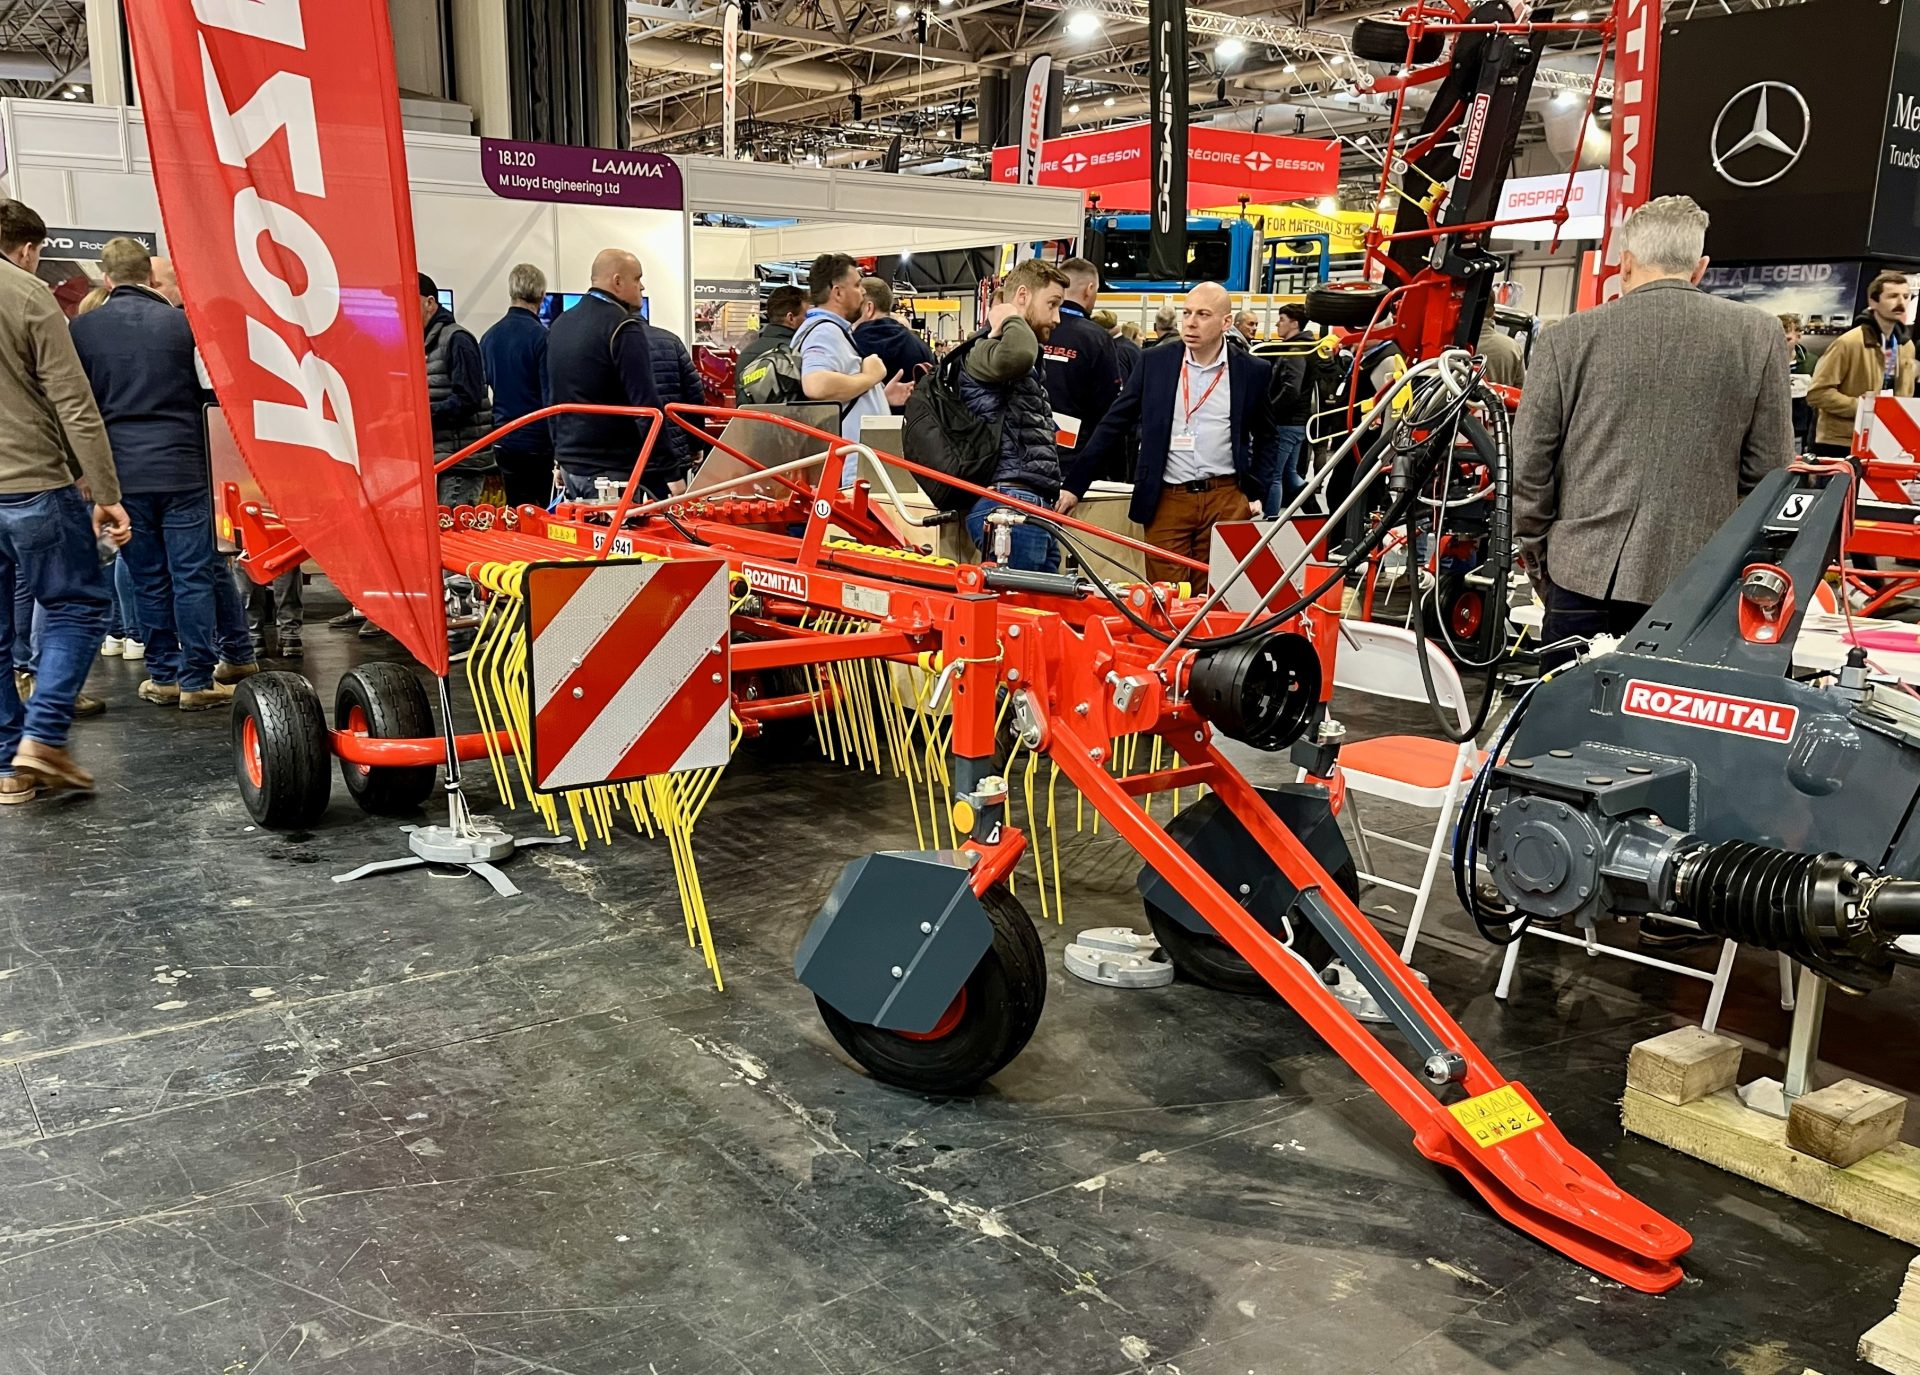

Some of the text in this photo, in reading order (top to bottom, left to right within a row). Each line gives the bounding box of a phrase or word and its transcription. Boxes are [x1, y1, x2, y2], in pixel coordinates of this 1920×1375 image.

[1461, 98, 1487, 174] ROZMITAL
[498, 149, 663, 179] 18.120 LAMMA
[1090, 148, 1140, 165] BESSON
[1187, 148, 1325, 172] RÉGOIRE BESSON
[1889, 144, 1920, 169] Trucks
[499, 174, 620, 197] M Lloyd Engineering Ltd
[1267, 217, 1286, 231] FOR
[1748, 263, 1833, 283] LEGEND
[744, 567, 805, 595] ROZMITAL
[1629, 687, 1786, 735] ROZMITAL
